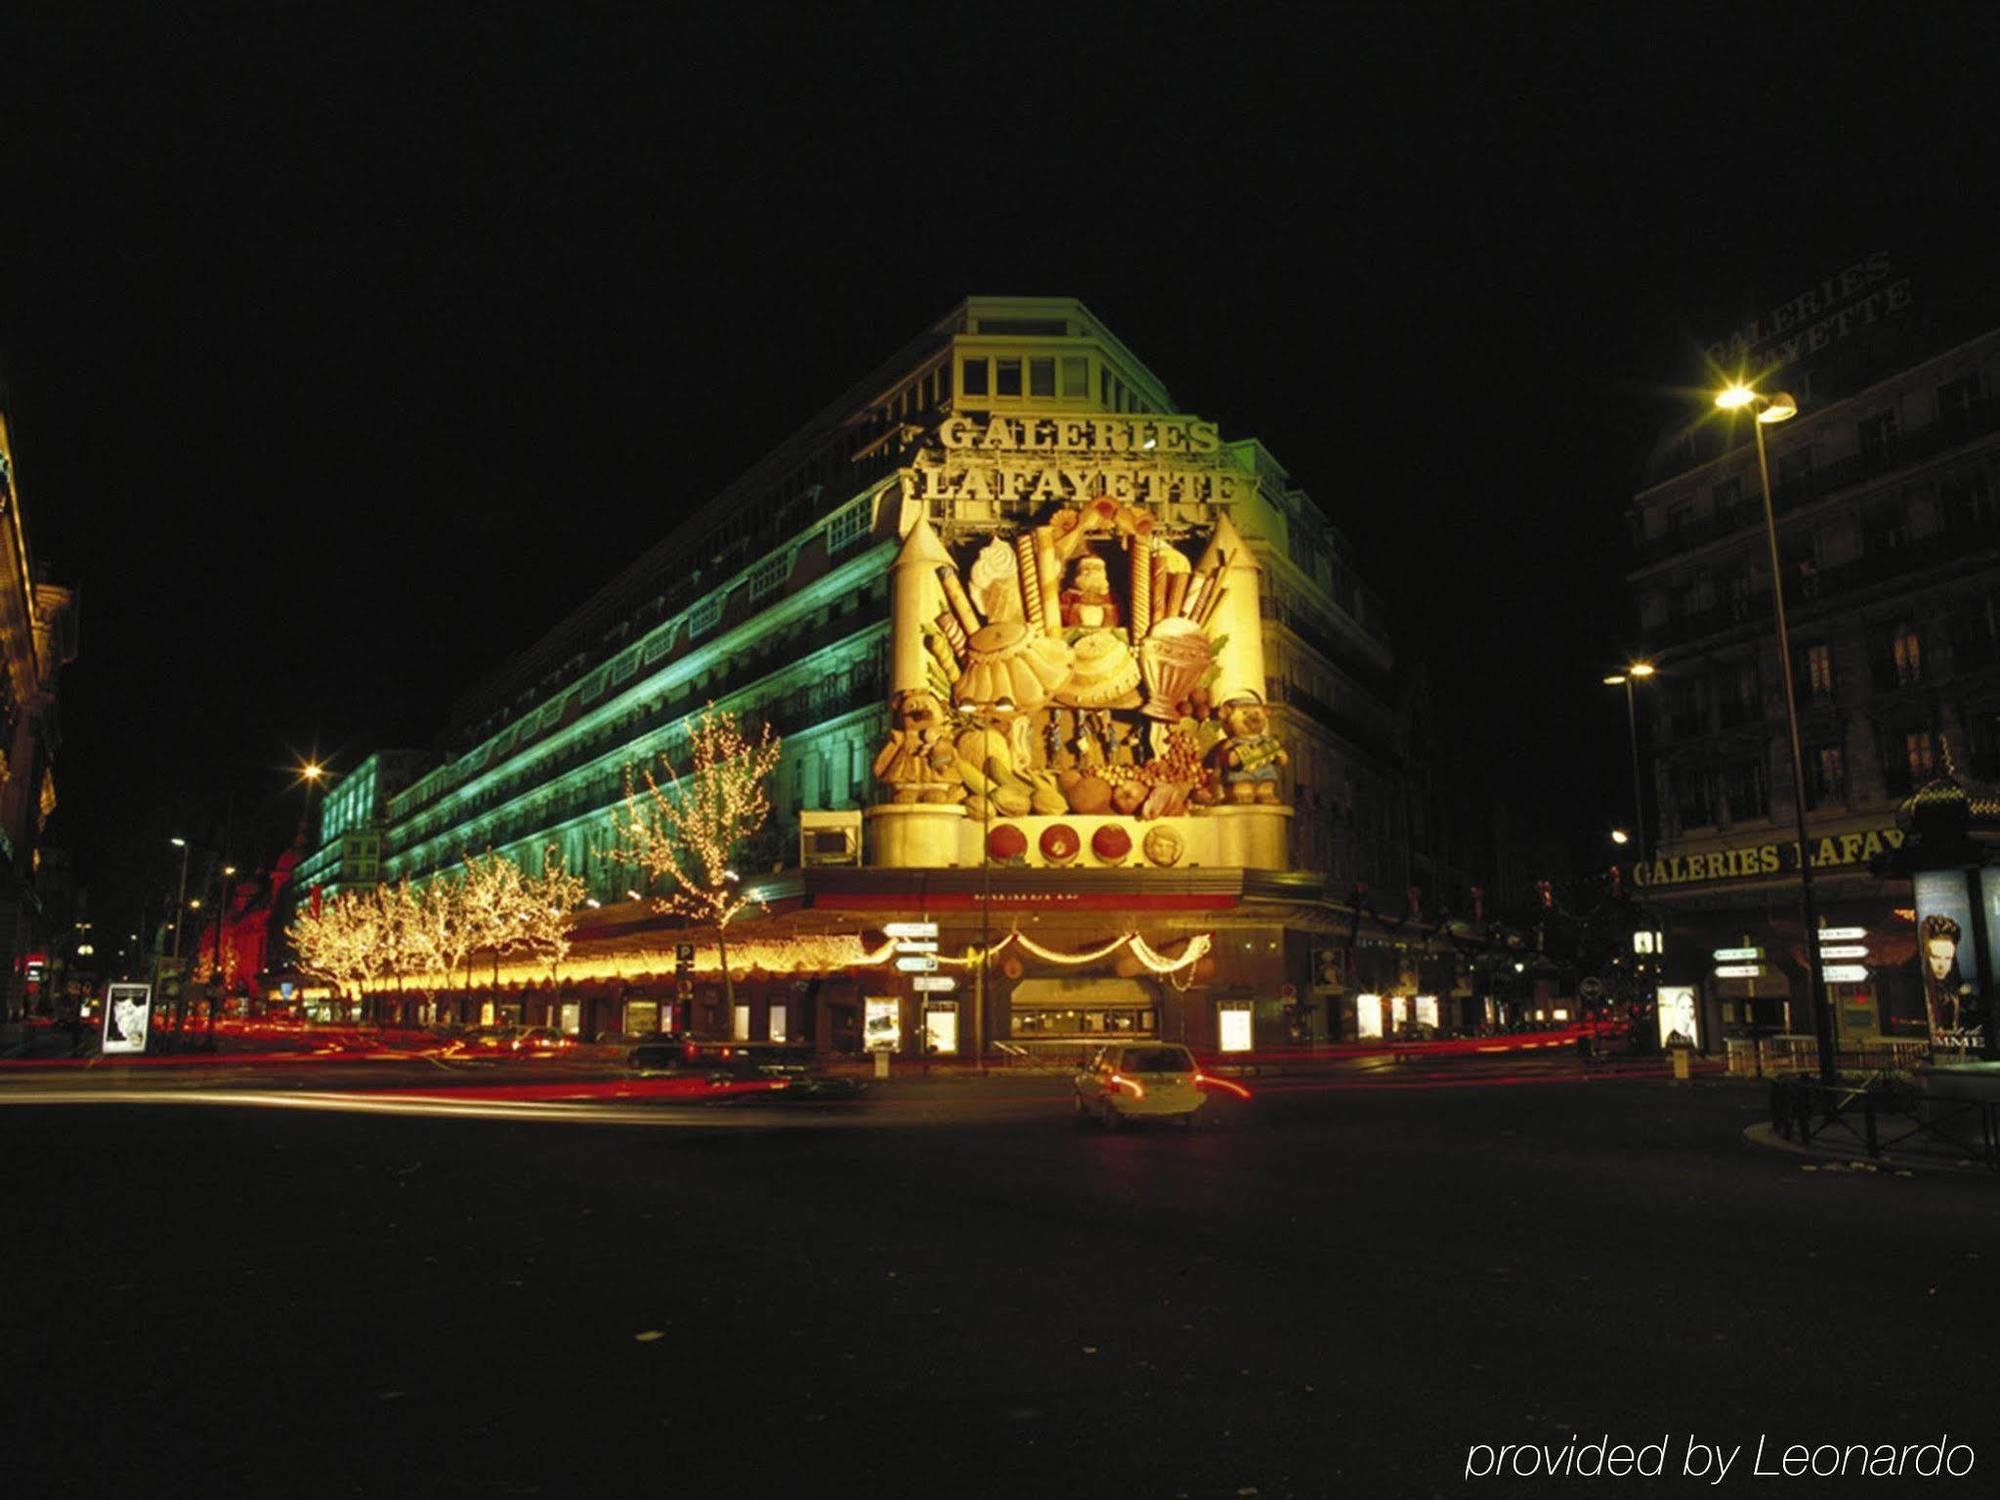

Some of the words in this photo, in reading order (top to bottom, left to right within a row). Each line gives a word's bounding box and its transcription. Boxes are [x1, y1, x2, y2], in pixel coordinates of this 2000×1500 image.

[939, 416, 1220, 453] GALERIES
[922, 467, 1239, 503] LAFAYETTE
[1632, 844, 1780, 888] GALERIES
